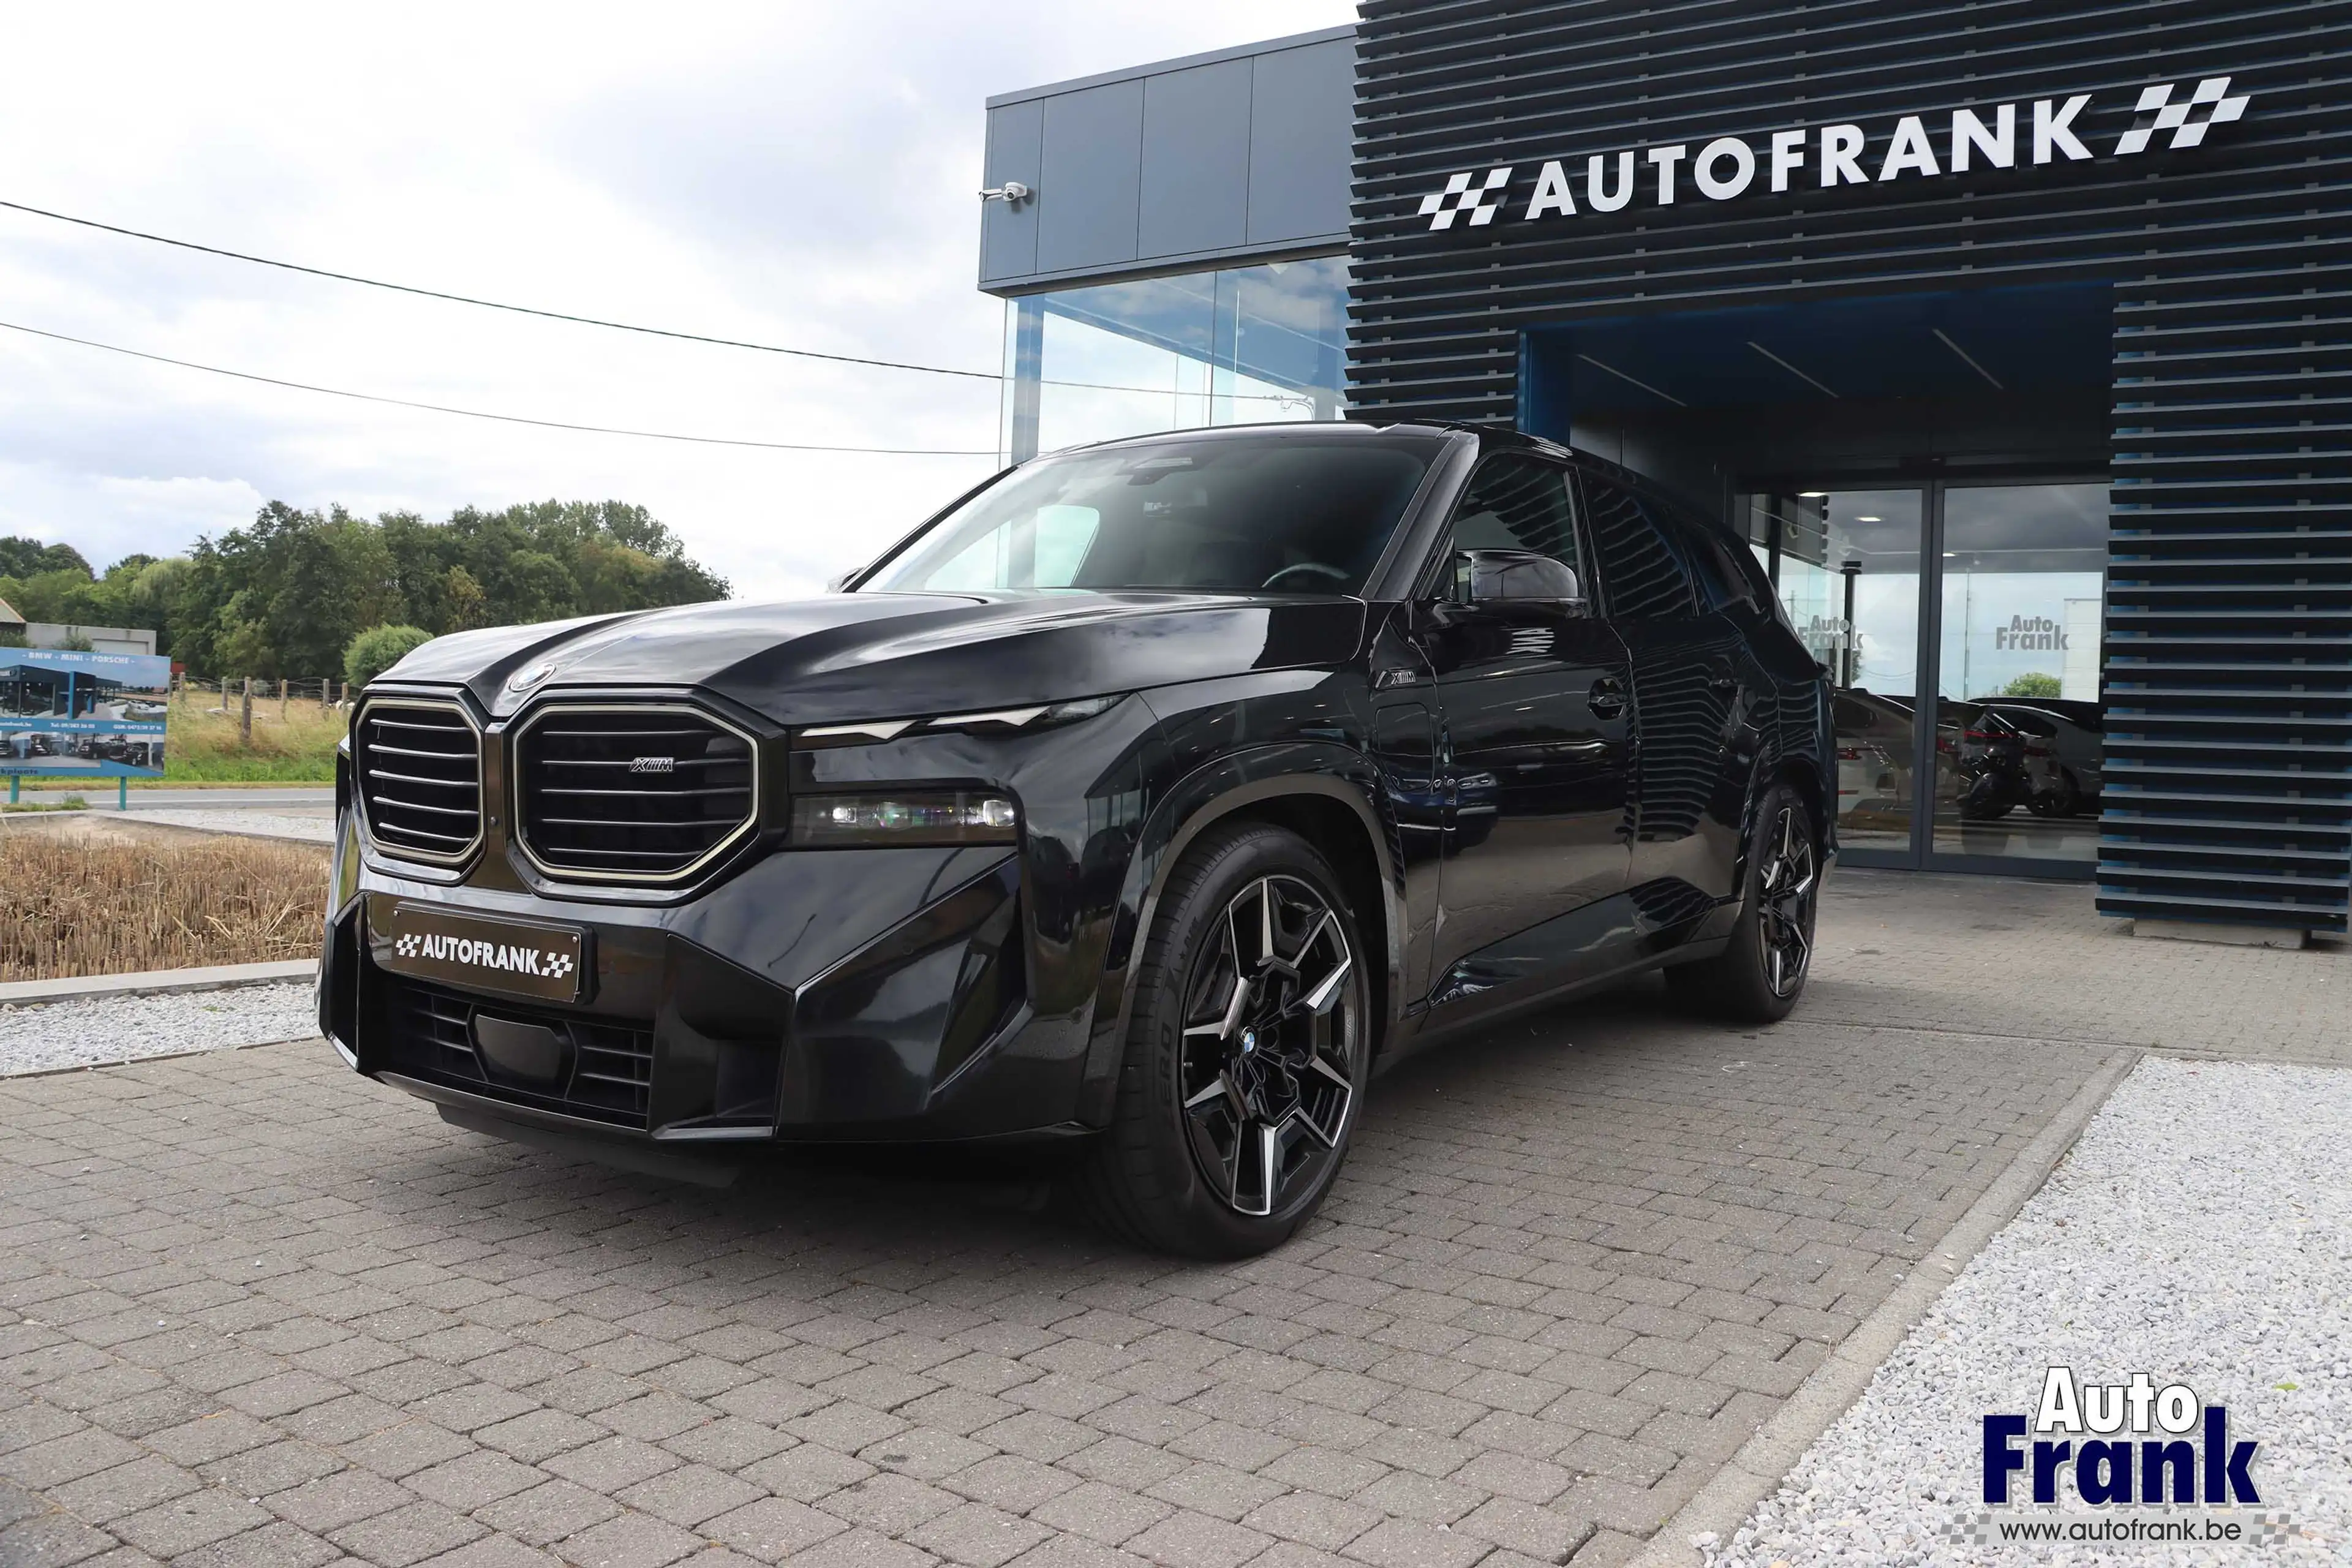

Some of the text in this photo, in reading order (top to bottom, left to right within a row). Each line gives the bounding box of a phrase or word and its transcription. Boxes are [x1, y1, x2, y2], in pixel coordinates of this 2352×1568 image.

[1525, 94, 2092, 221] AUTOFRANK
[1810, 615, 1850, 631] Auto
[2010, 614, 2054, 632] Auto
[1798, 625, 1864, 649] Frank
[1996, 625, 2070, 650] Frank
[61, 654, 83, 662] MINI
[92, 655, 129, 665] PORSCHE
[421, 933, 540, 975] AUTOFRANK
